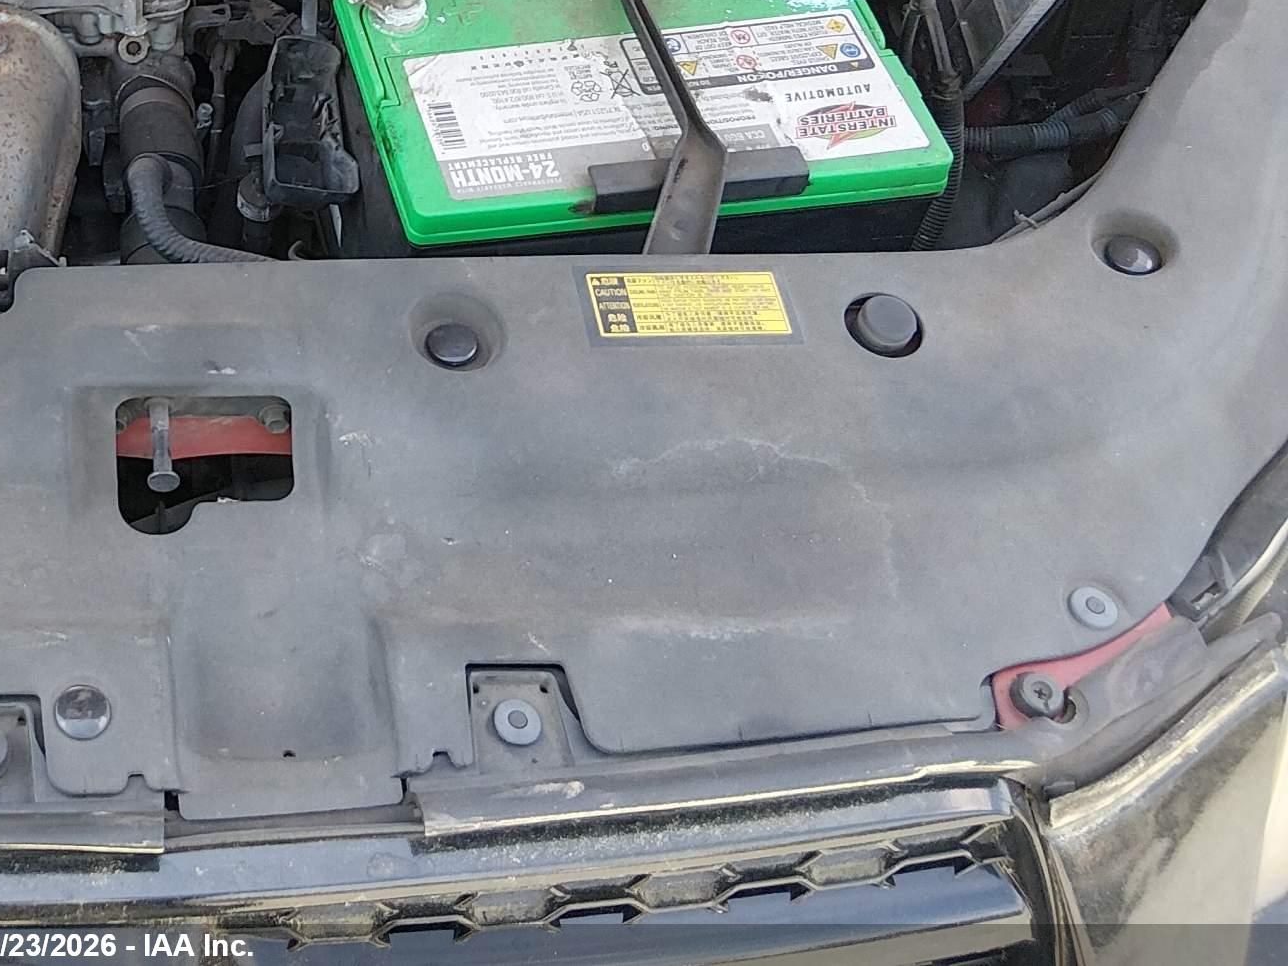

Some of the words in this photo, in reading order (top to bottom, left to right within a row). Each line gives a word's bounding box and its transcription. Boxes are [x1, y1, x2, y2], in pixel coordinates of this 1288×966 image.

[784, 83, 871, 102] AUTOMOTIVE
[798, 107, 886, 126] BATTERIES
[798, 117, 894, 138] INTERSTATE
[447, 155, 522, 171] REPLACEMENT
[526, 152, 554, 163] FREE
[450, 160, 561, 189] 24-MONTH
[594, 288, 628, 297] CAUTION
[598, 302, 631, 310] ATTENTION
